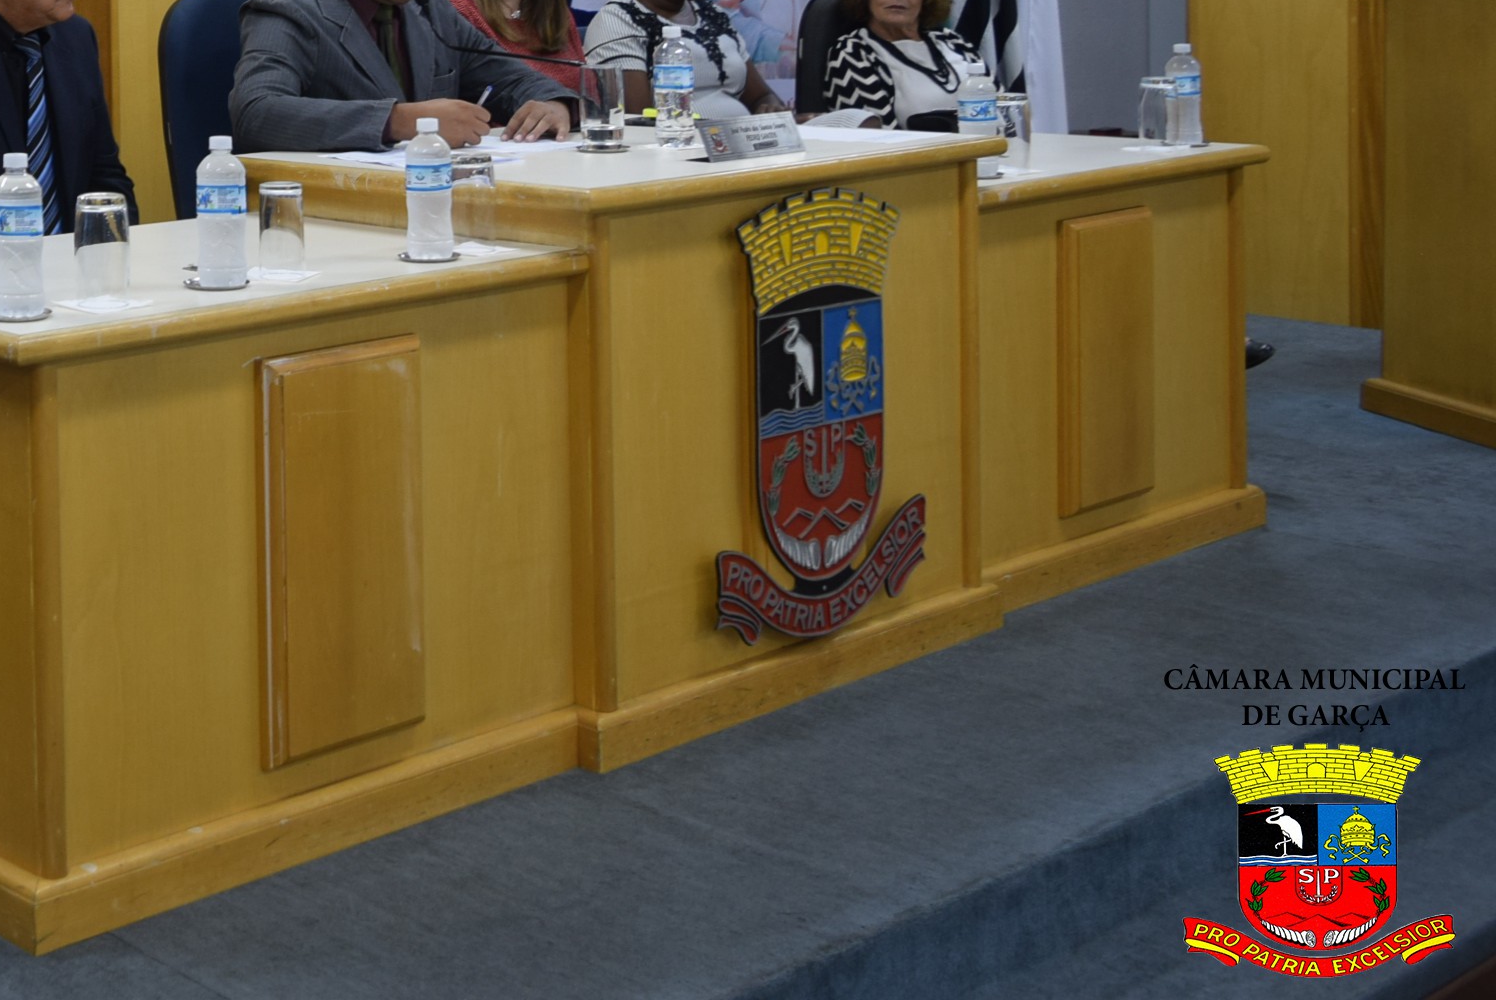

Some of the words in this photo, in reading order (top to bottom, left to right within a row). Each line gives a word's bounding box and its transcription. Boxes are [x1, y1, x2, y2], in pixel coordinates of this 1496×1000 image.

[726, 561, 765, 601] PRO
[761, 586, 825, 631] PATRIA
[828, 506, 921, 625] EXCELSIOR
